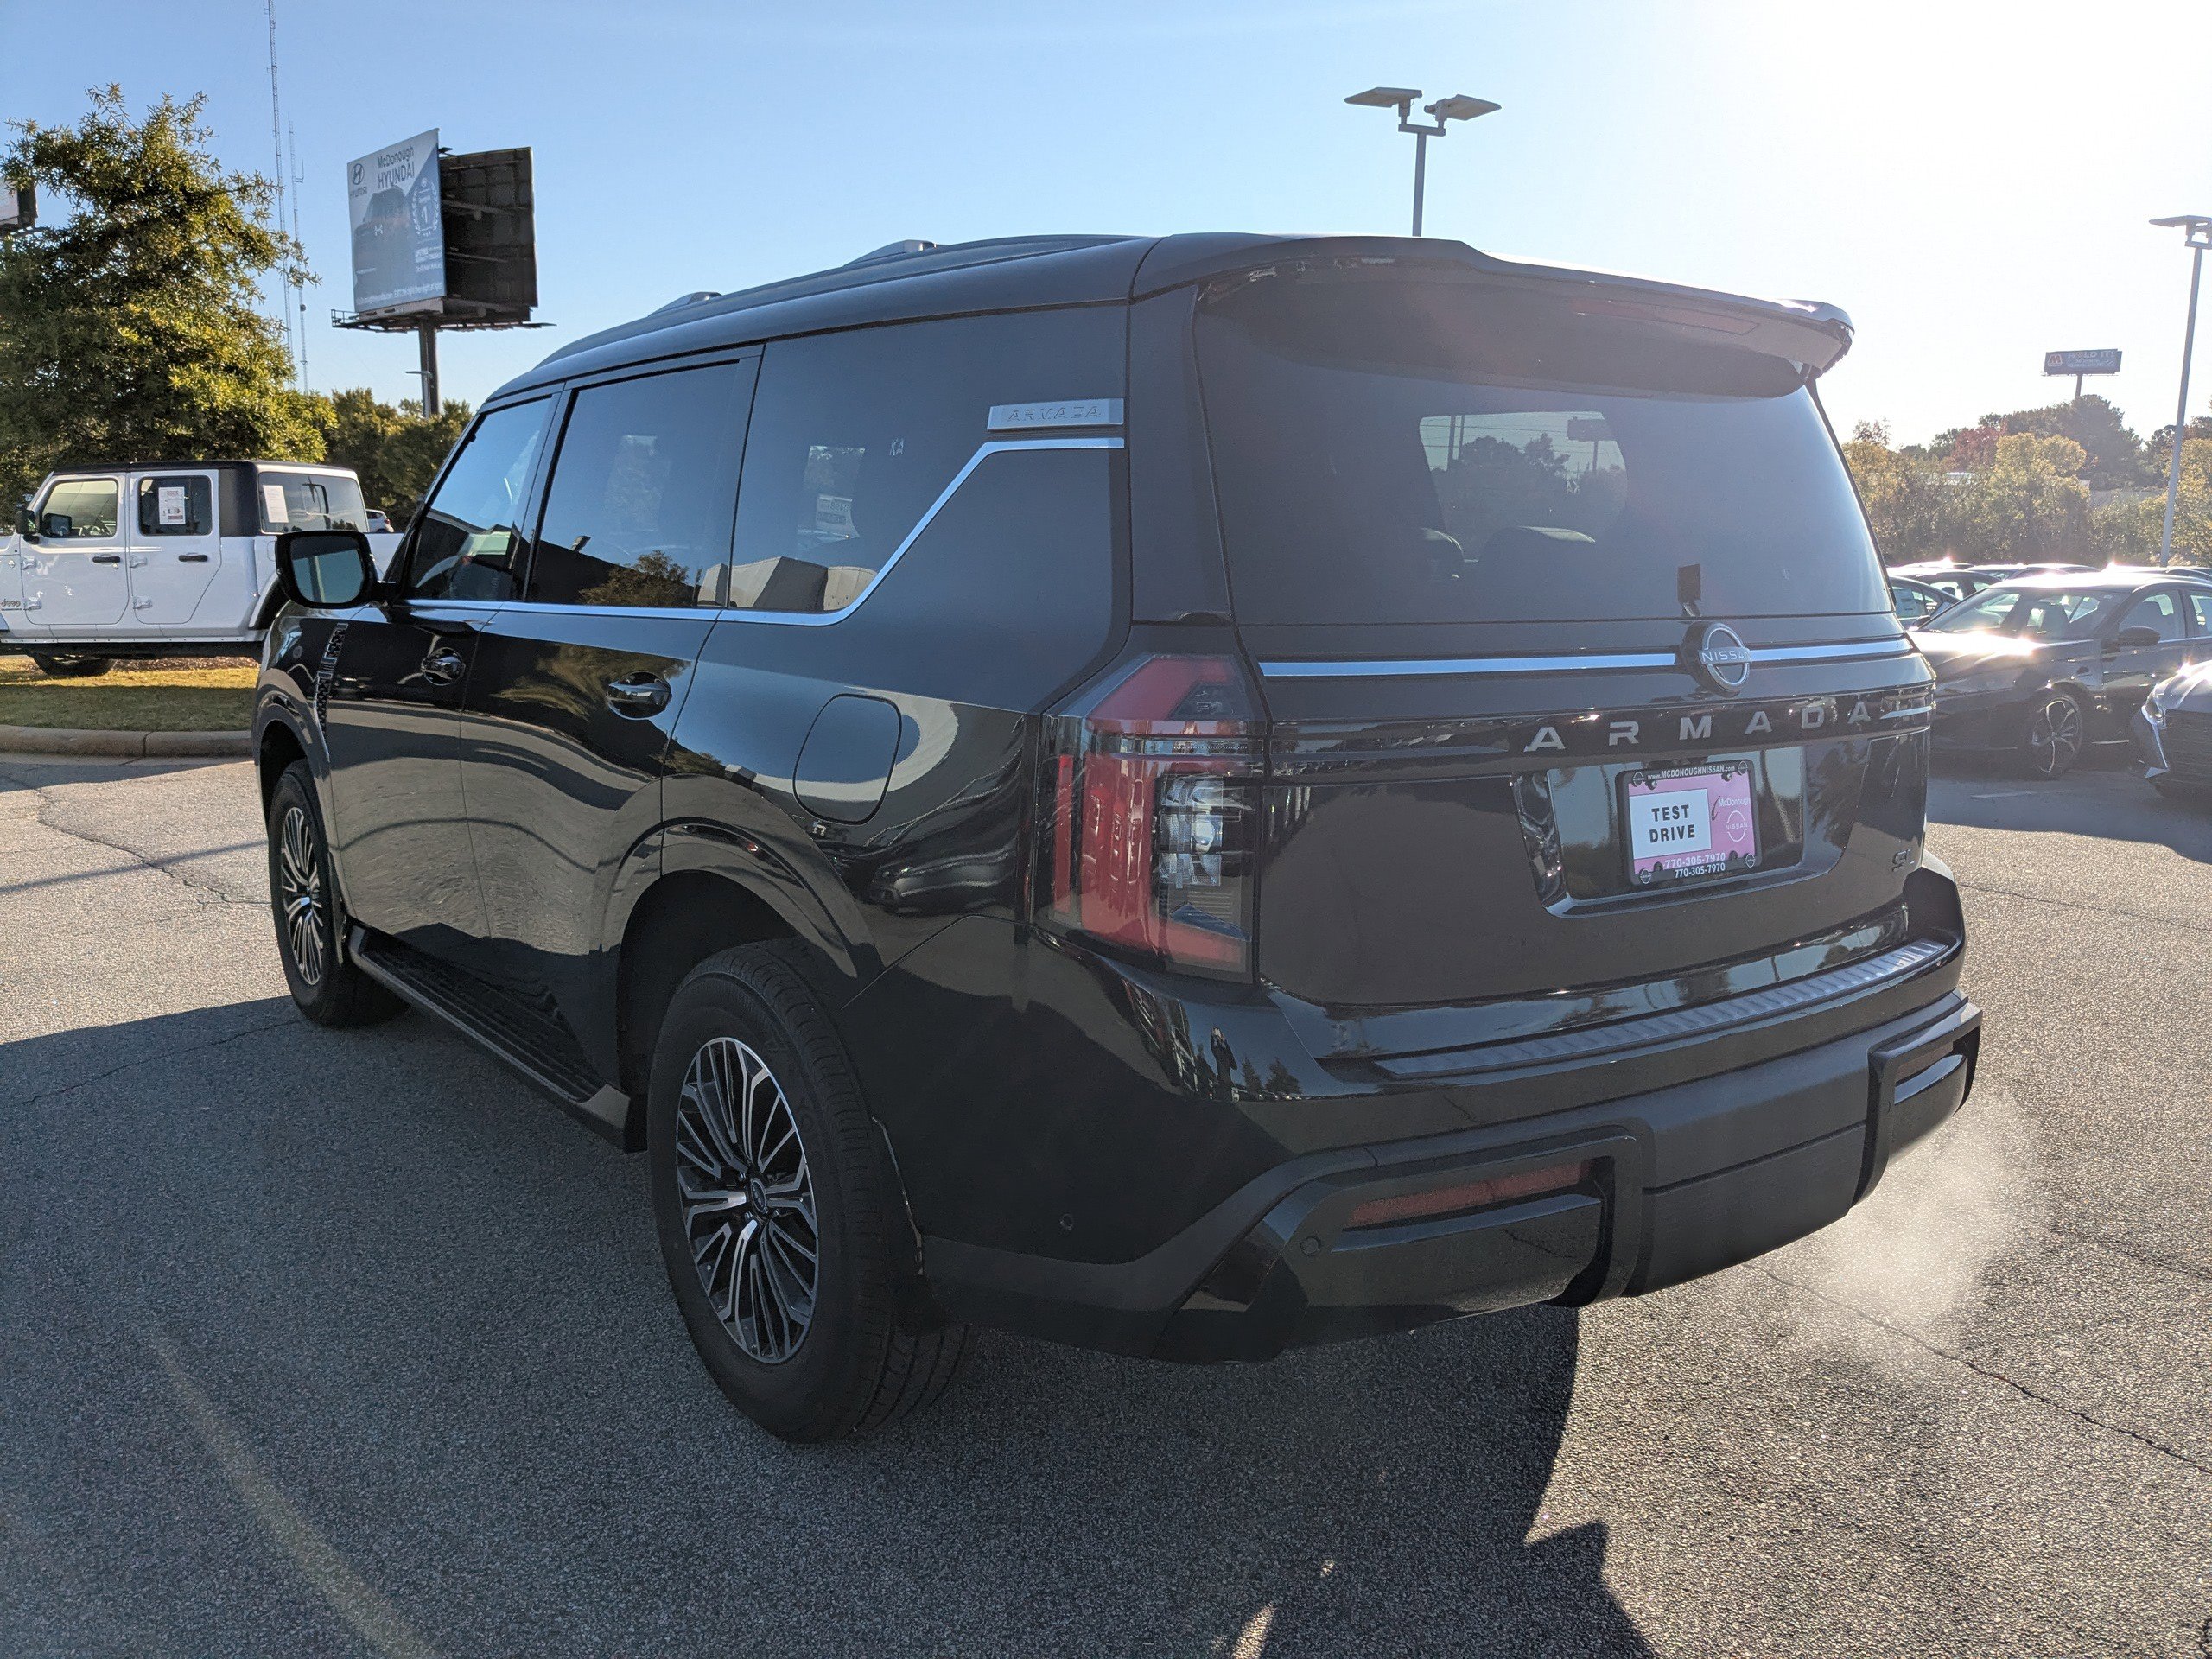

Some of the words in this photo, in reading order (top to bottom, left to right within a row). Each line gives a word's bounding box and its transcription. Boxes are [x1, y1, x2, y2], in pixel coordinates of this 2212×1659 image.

[377, 145, 415, 168] McDonough
[377, 162, 415, 189] HYUNDAI
[1523, 702, 1872, 752] ARMADA
[1647, 765, 1735, 779] www.MCDONOUGHNISSAN.com
[1651, 804, 1689, 822] TEST
[1649, 824, 1695, 843] DRIVE
[1674, 862, 1726, 879] 770-305-7970
